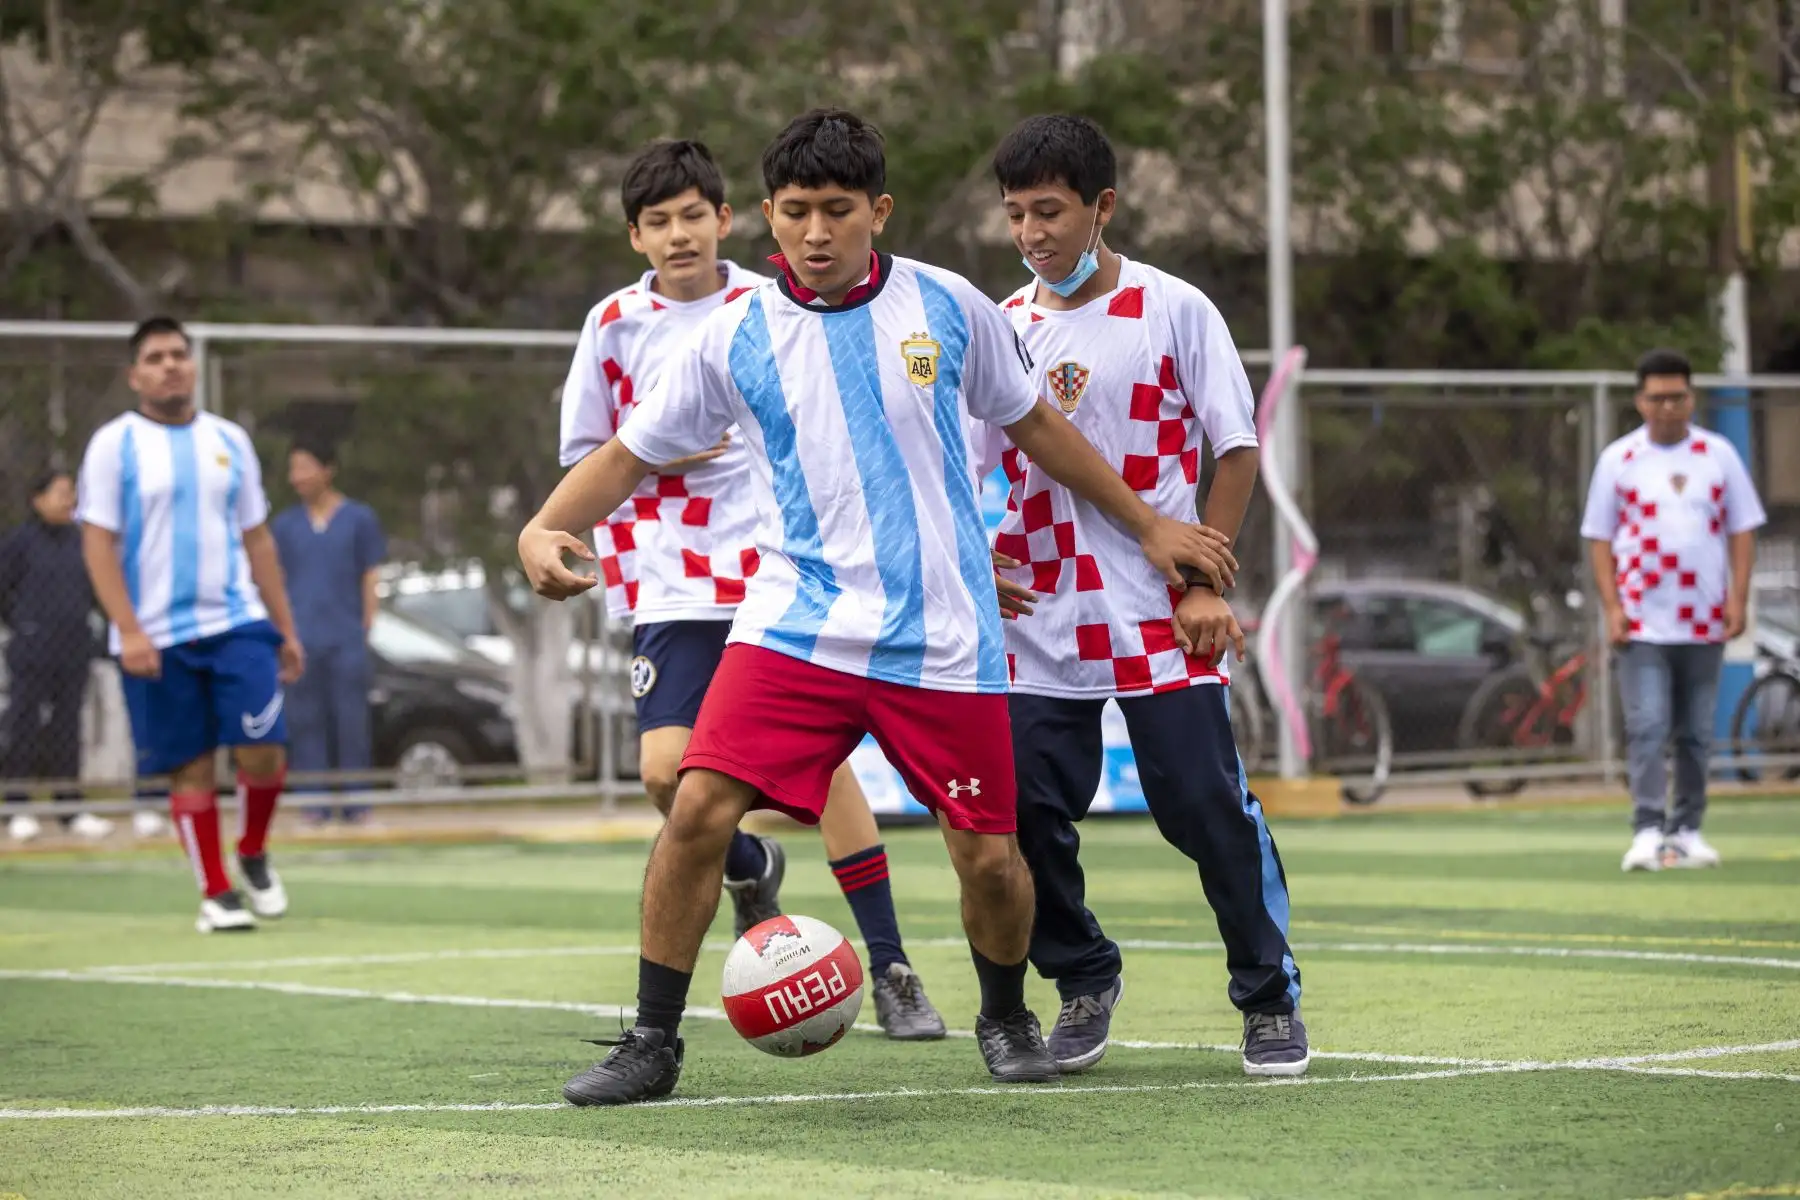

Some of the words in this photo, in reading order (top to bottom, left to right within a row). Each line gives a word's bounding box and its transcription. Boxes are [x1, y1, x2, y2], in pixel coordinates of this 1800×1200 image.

[911, 356, 933, 378] AFA
[775, 944, 811, 967] Winner
[764, 961, 847, 1024] PERU
